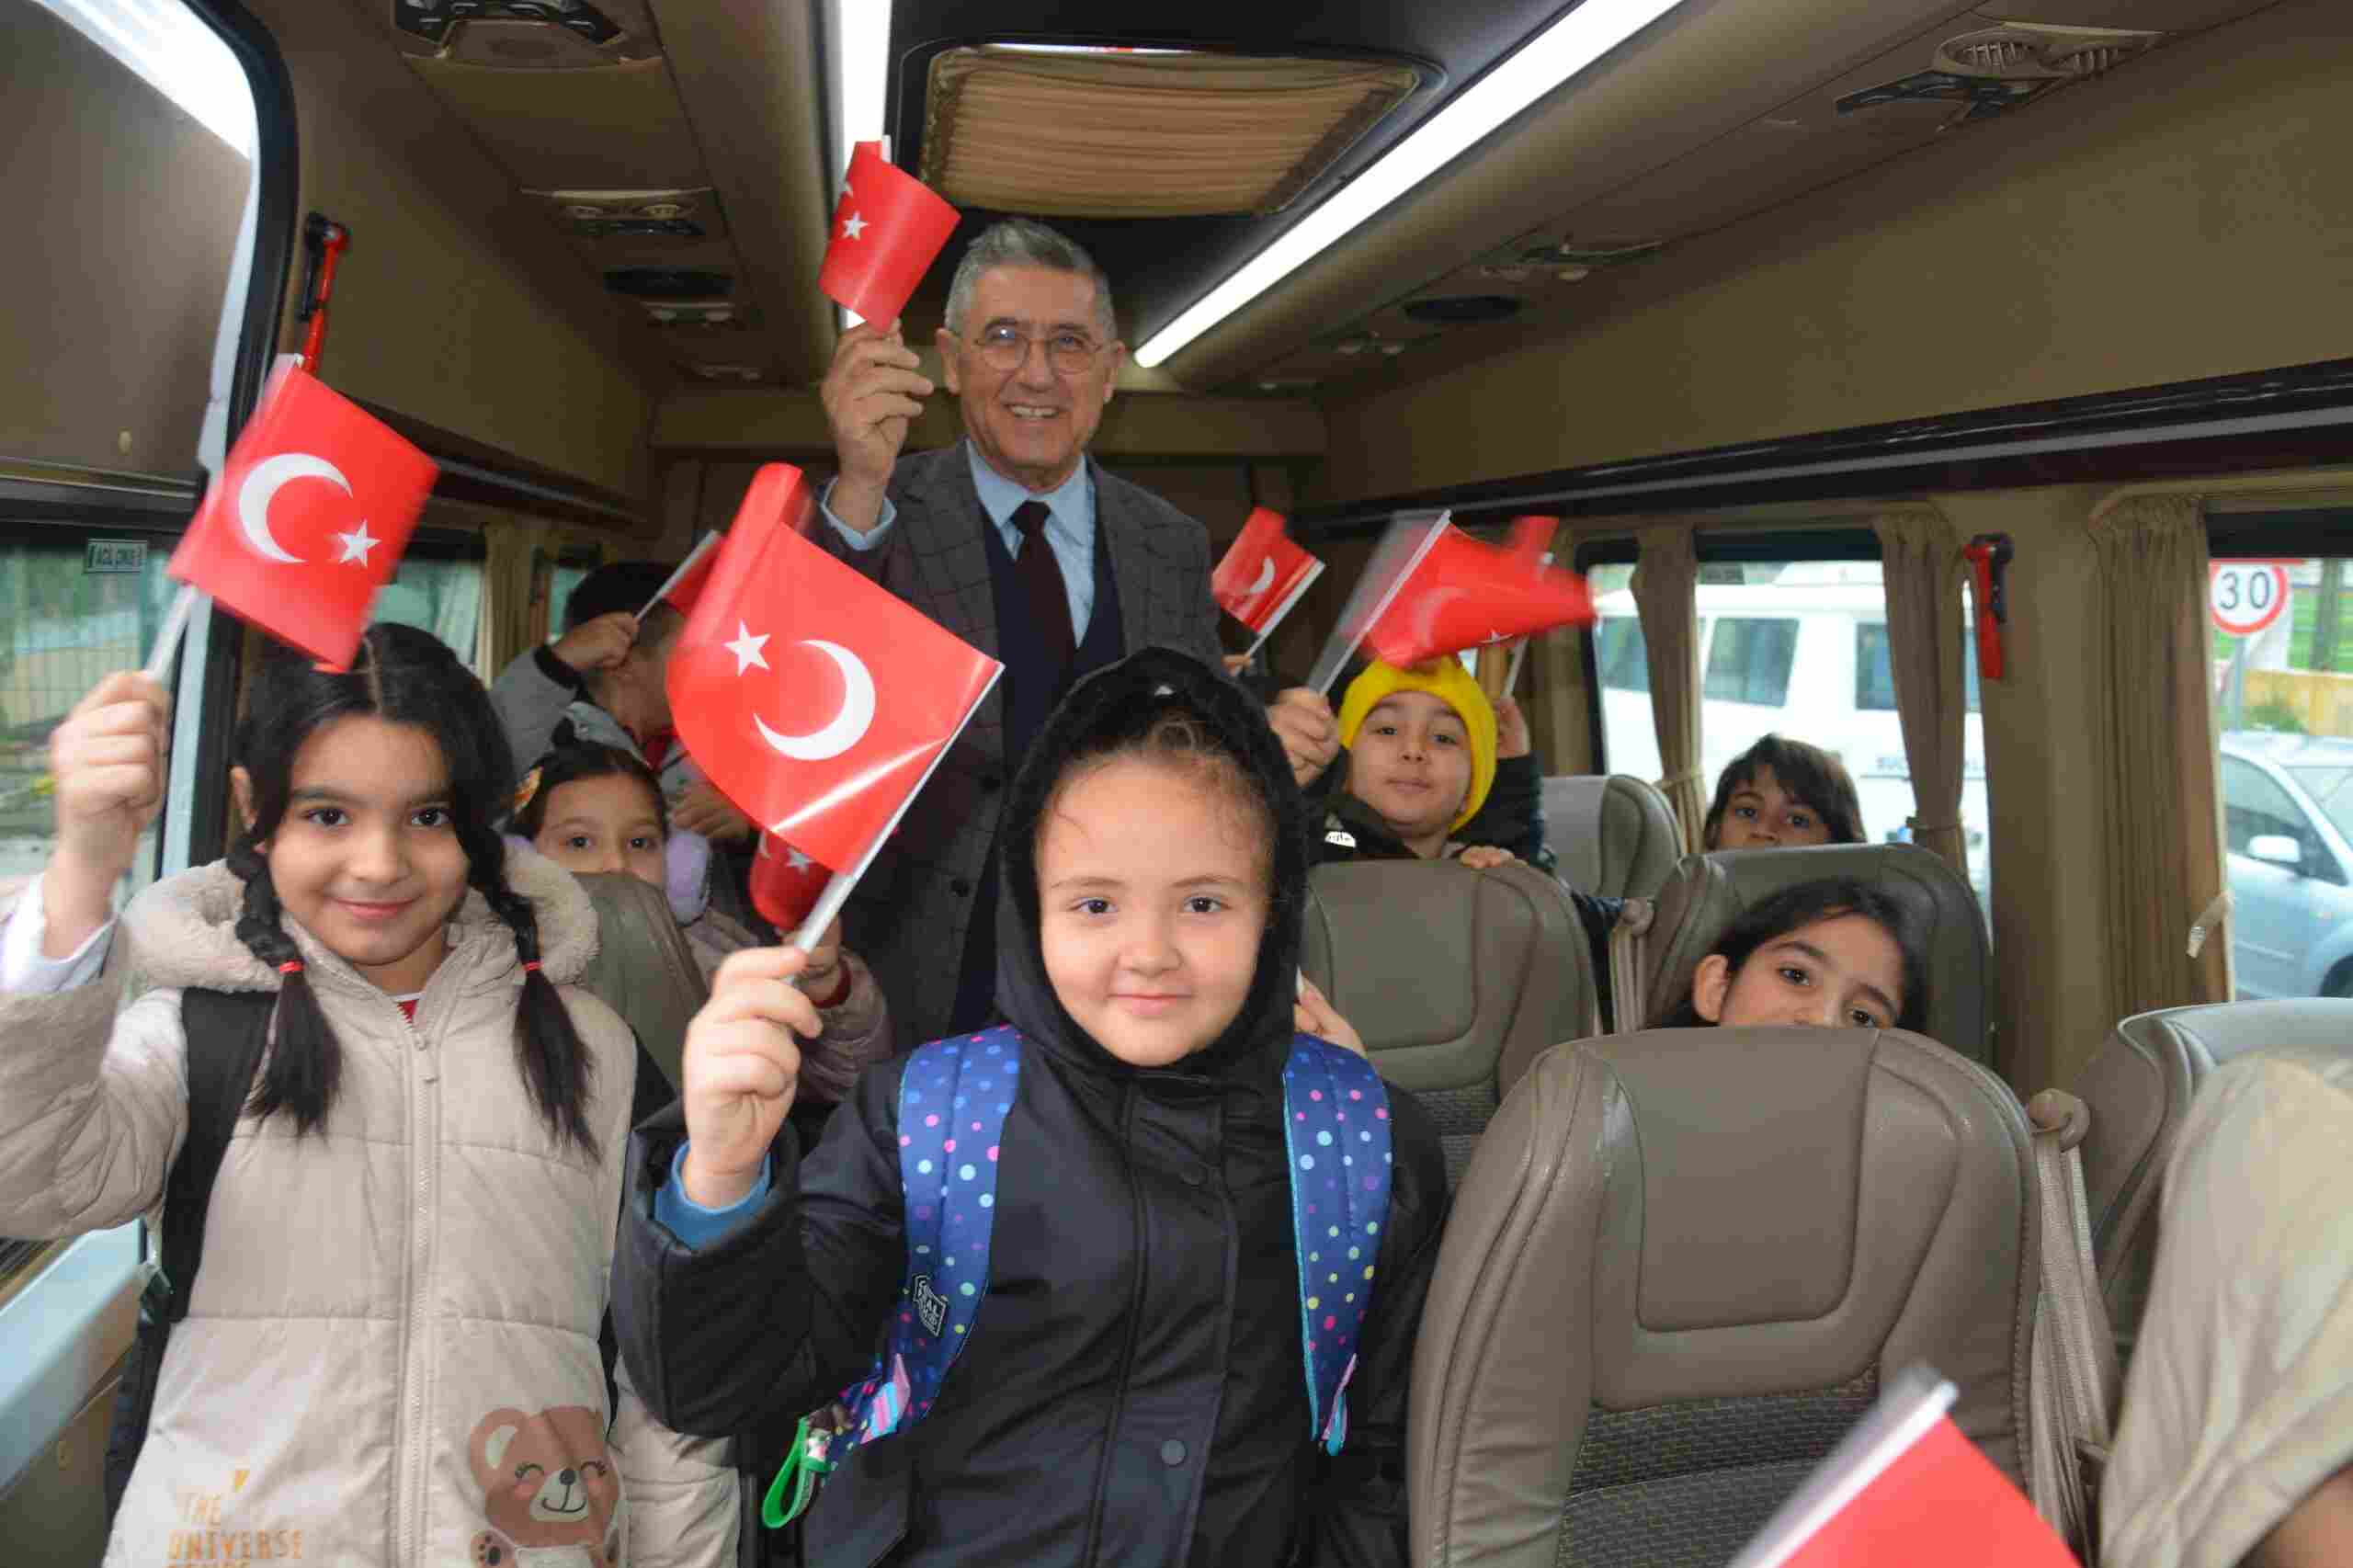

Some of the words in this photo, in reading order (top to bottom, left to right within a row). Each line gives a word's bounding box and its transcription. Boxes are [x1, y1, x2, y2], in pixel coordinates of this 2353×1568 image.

[2220, 572, 2270, 608] 30
[181, 1494, 222, 1526] THE
[167, 1529, 303, 1560] UNIVERSE
